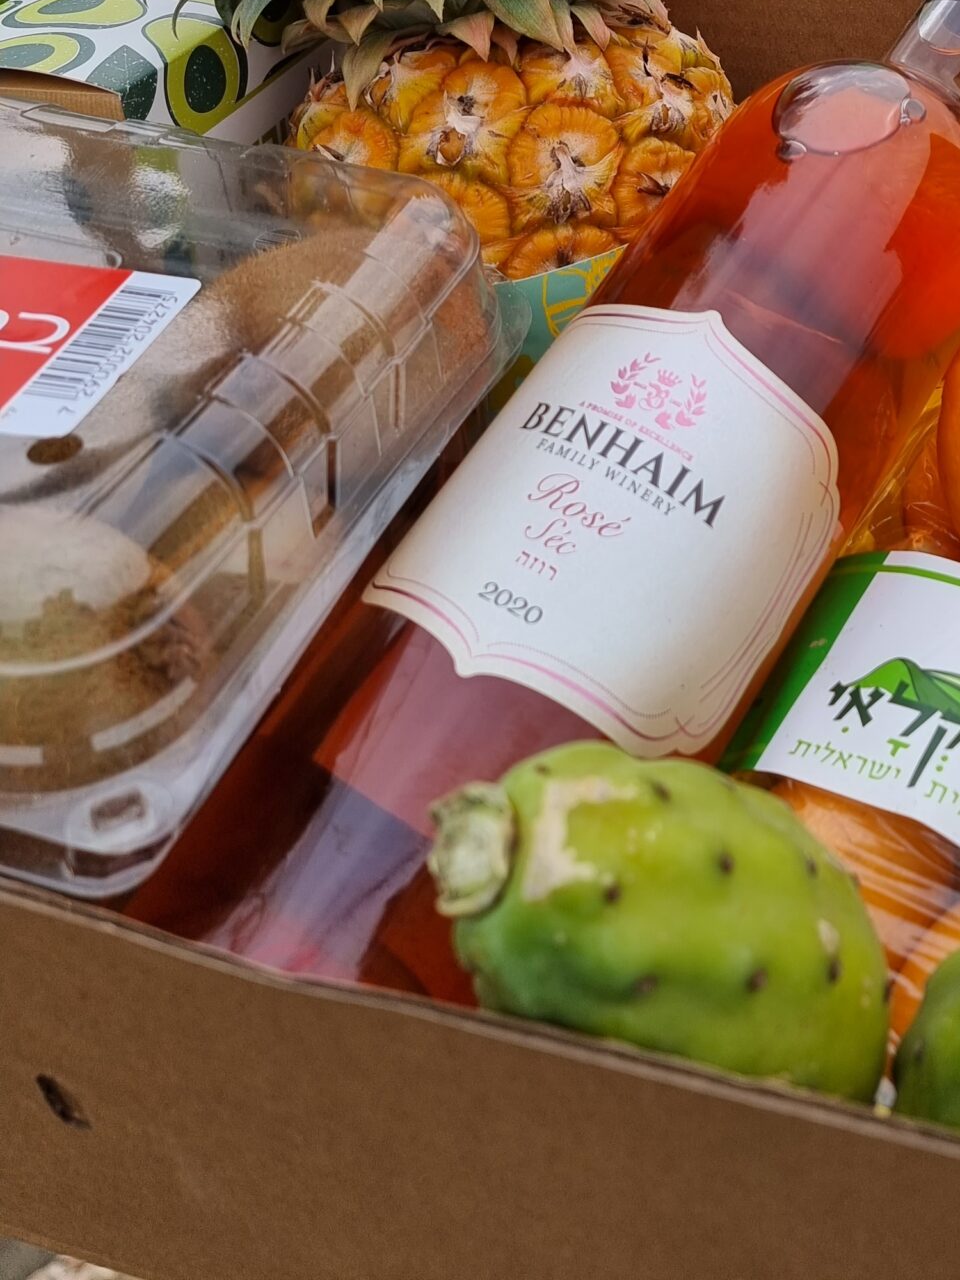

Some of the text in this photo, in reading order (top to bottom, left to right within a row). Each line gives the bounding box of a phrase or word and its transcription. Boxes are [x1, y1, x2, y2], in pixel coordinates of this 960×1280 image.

[587, 402, 624, 423] PROMISE
[624, 417, 638, 428] OF
[637, 423, 695, 463] EXCELLENCE
[520, 401, 728, 530] BENHAIM
[535, 437, 678, 516] FAMILY WINERY
[526, 472, 632, 538] Rosé
[514, 550, 559, 582] רוזה
[477, 581, 544, 626] 2020
[788, 736, 902, 784] ישראלית
